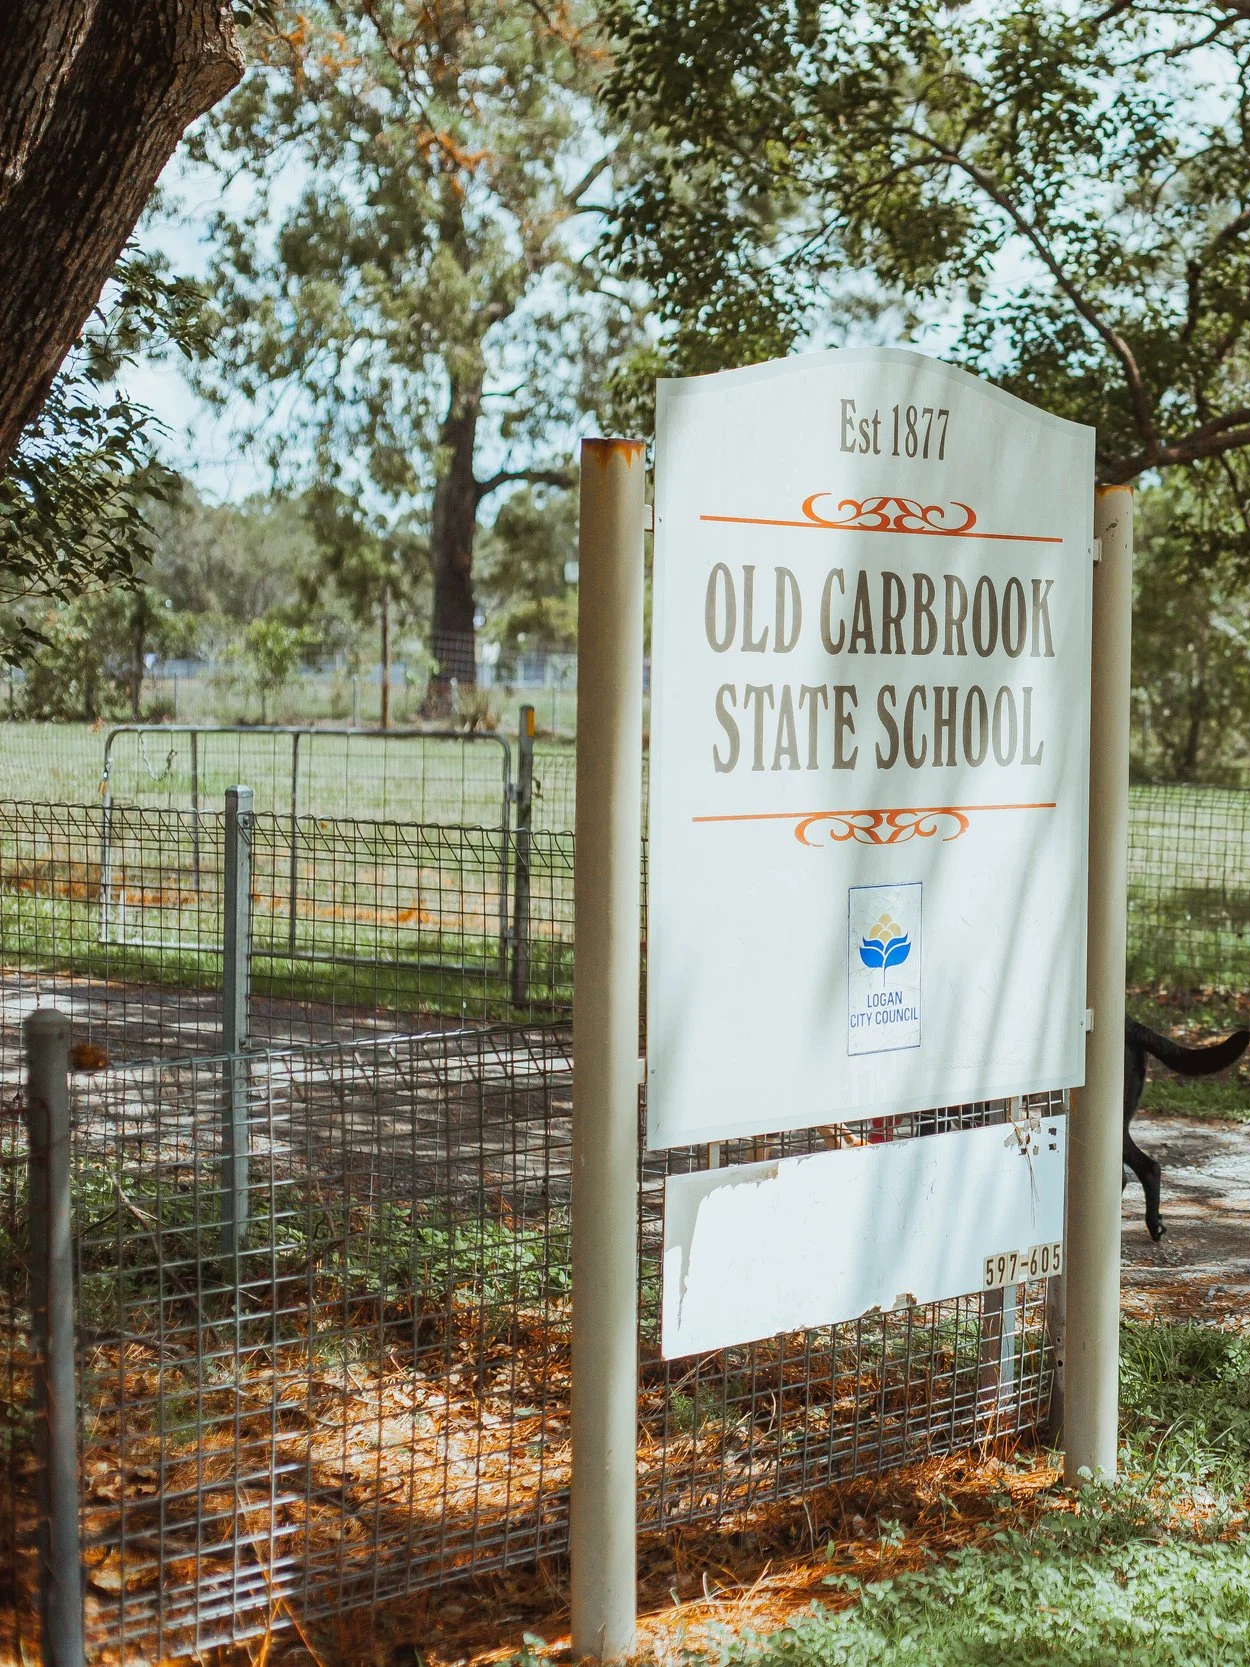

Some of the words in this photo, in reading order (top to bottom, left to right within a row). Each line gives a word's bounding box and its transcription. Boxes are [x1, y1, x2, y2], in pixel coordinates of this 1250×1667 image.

[840, 399, 881, 455] Est
[892, 404, 950, 460] 1877
[705, 562, 802, 654] OLD
[820, 567, 1055, 658] CARBROOK
[712, 683, 859, 773] STATE
[875, 684, 1044, 770] SCHOOL
[850, 1012, 872, 1028] CITY
[875, 1007, 918, 1025] COUNCIL
[867, 991, 903, 1008] LOGAN
[986, 1244, 1061, 1286] 597-605
